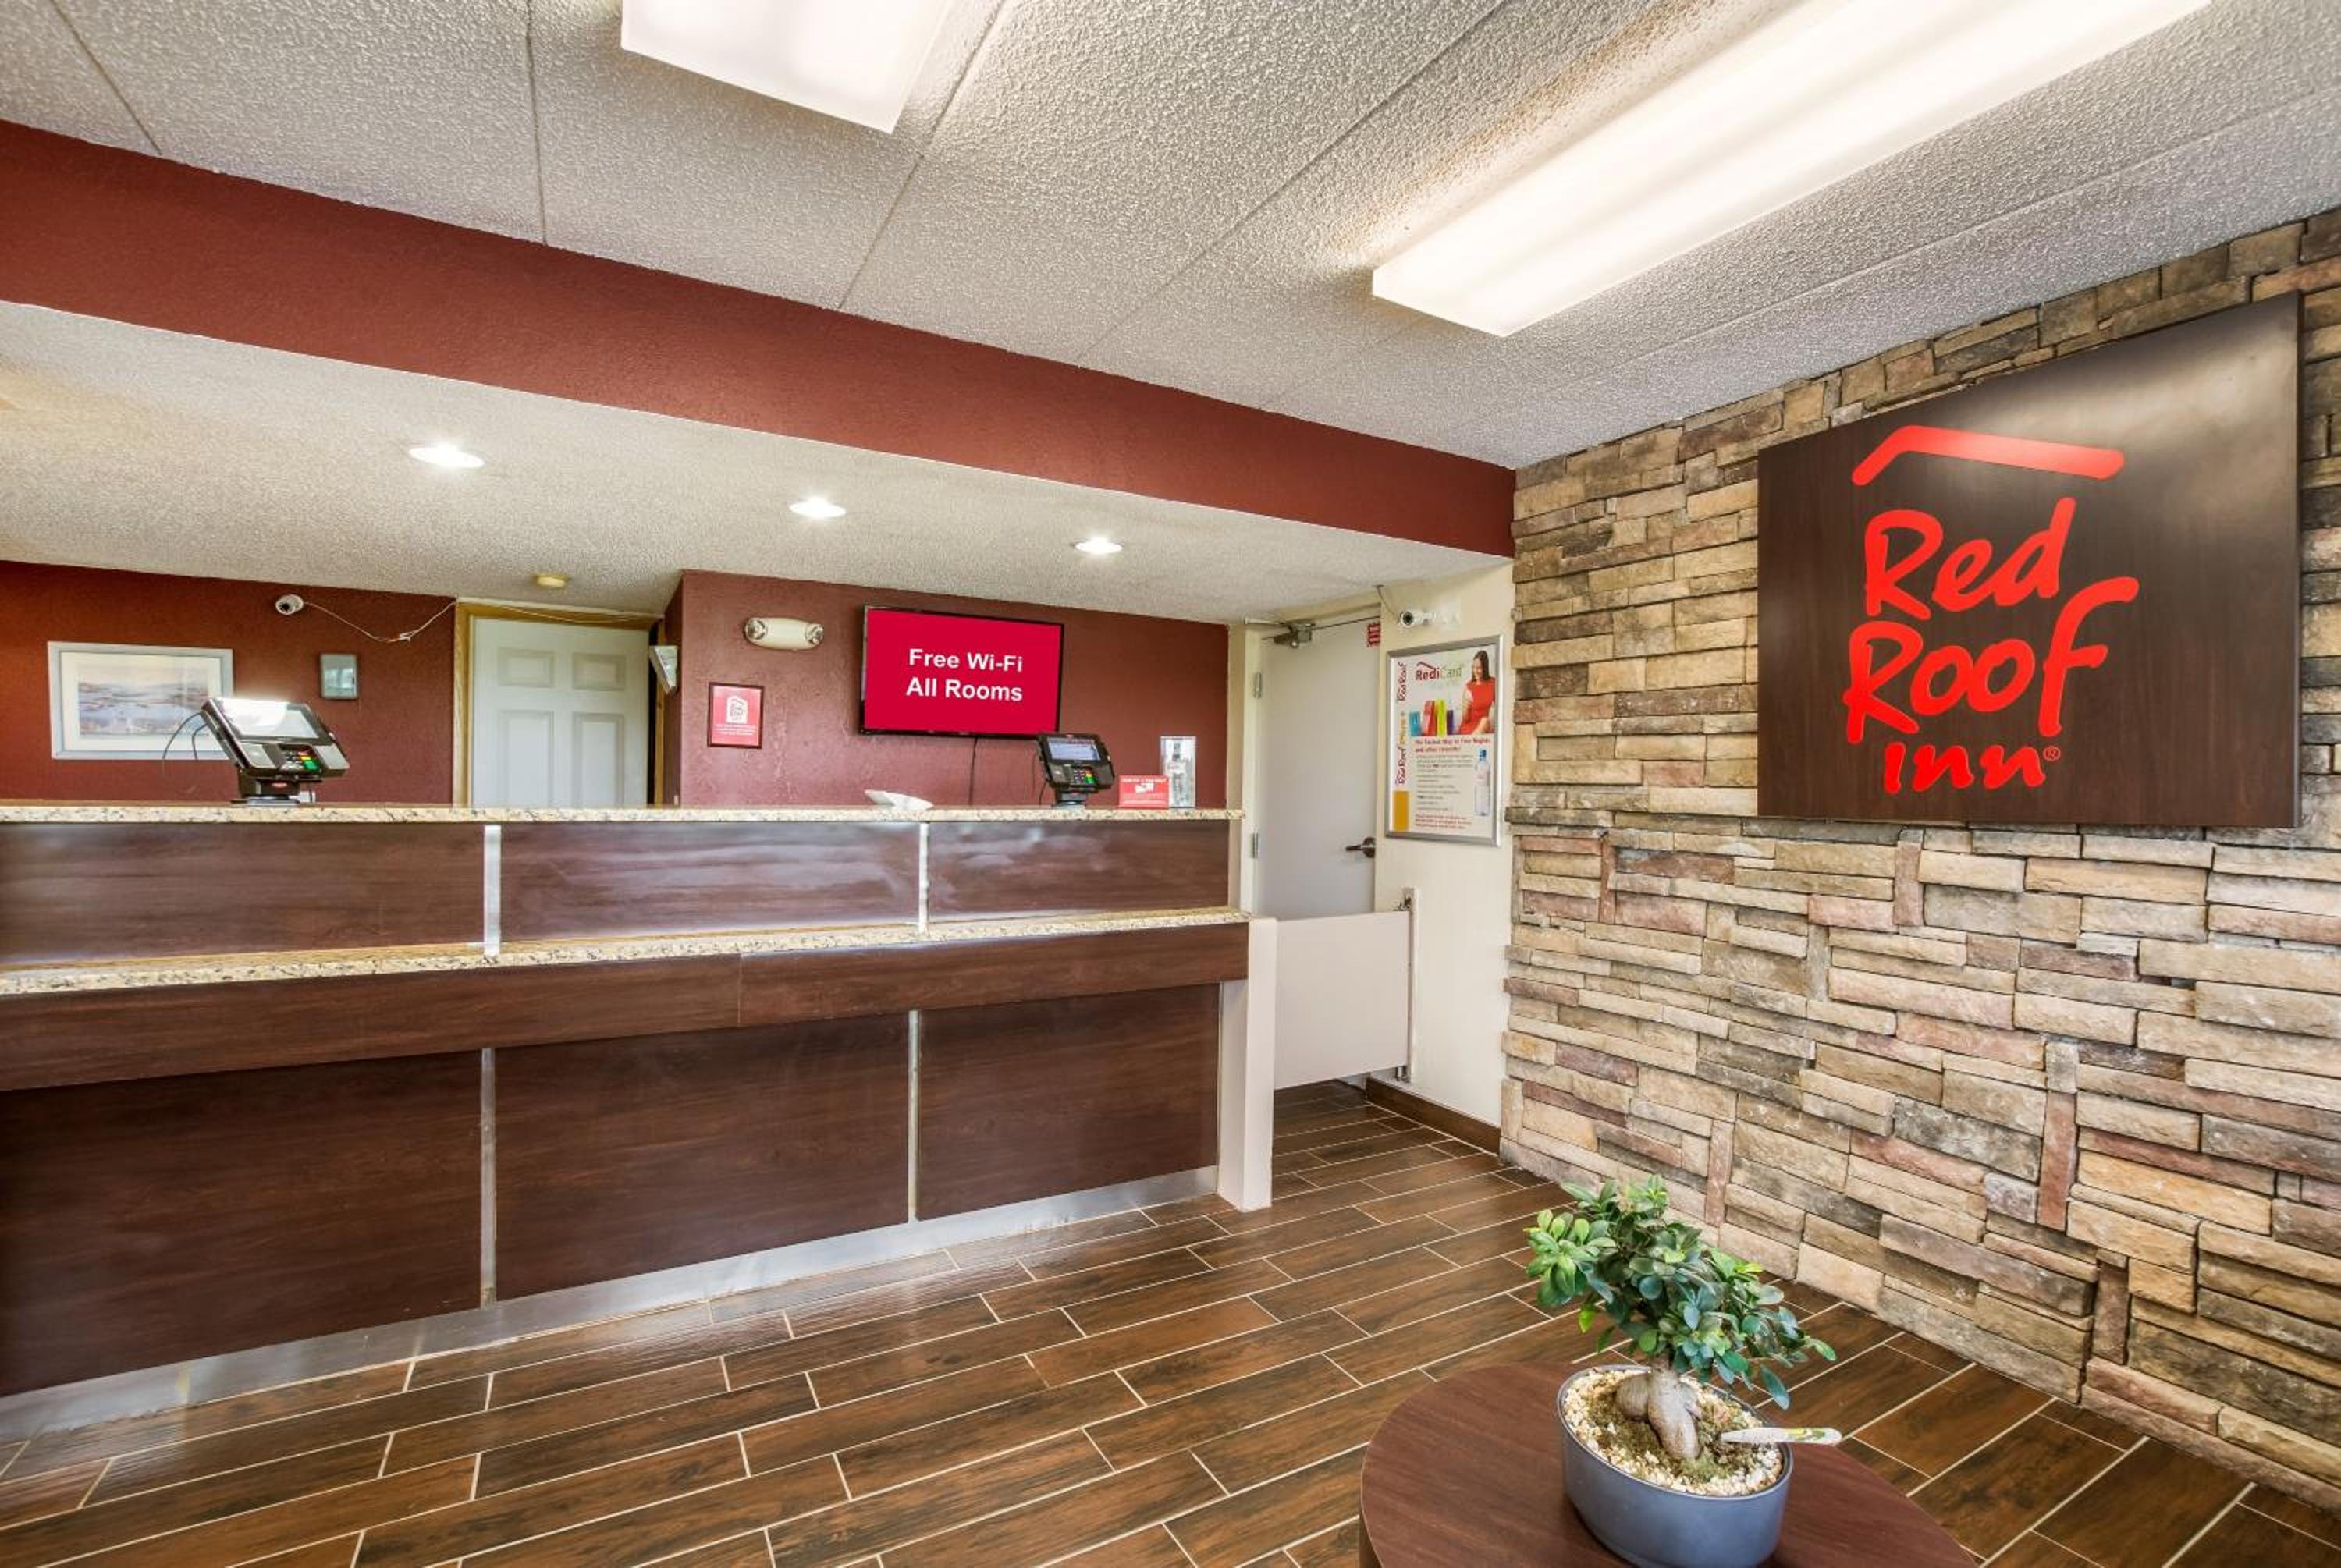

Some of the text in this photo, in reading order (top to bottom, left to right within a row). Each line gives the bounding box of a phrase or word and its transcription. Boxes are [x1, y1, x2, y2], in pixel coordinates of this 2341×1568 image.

[1863, 498, 2076, 622] Red
[905, 676, 1023, 701] All Rooms
[908, 648, 1023, 672] Free Wi-Fi
[1842, 576, 2140, 746] Roof
